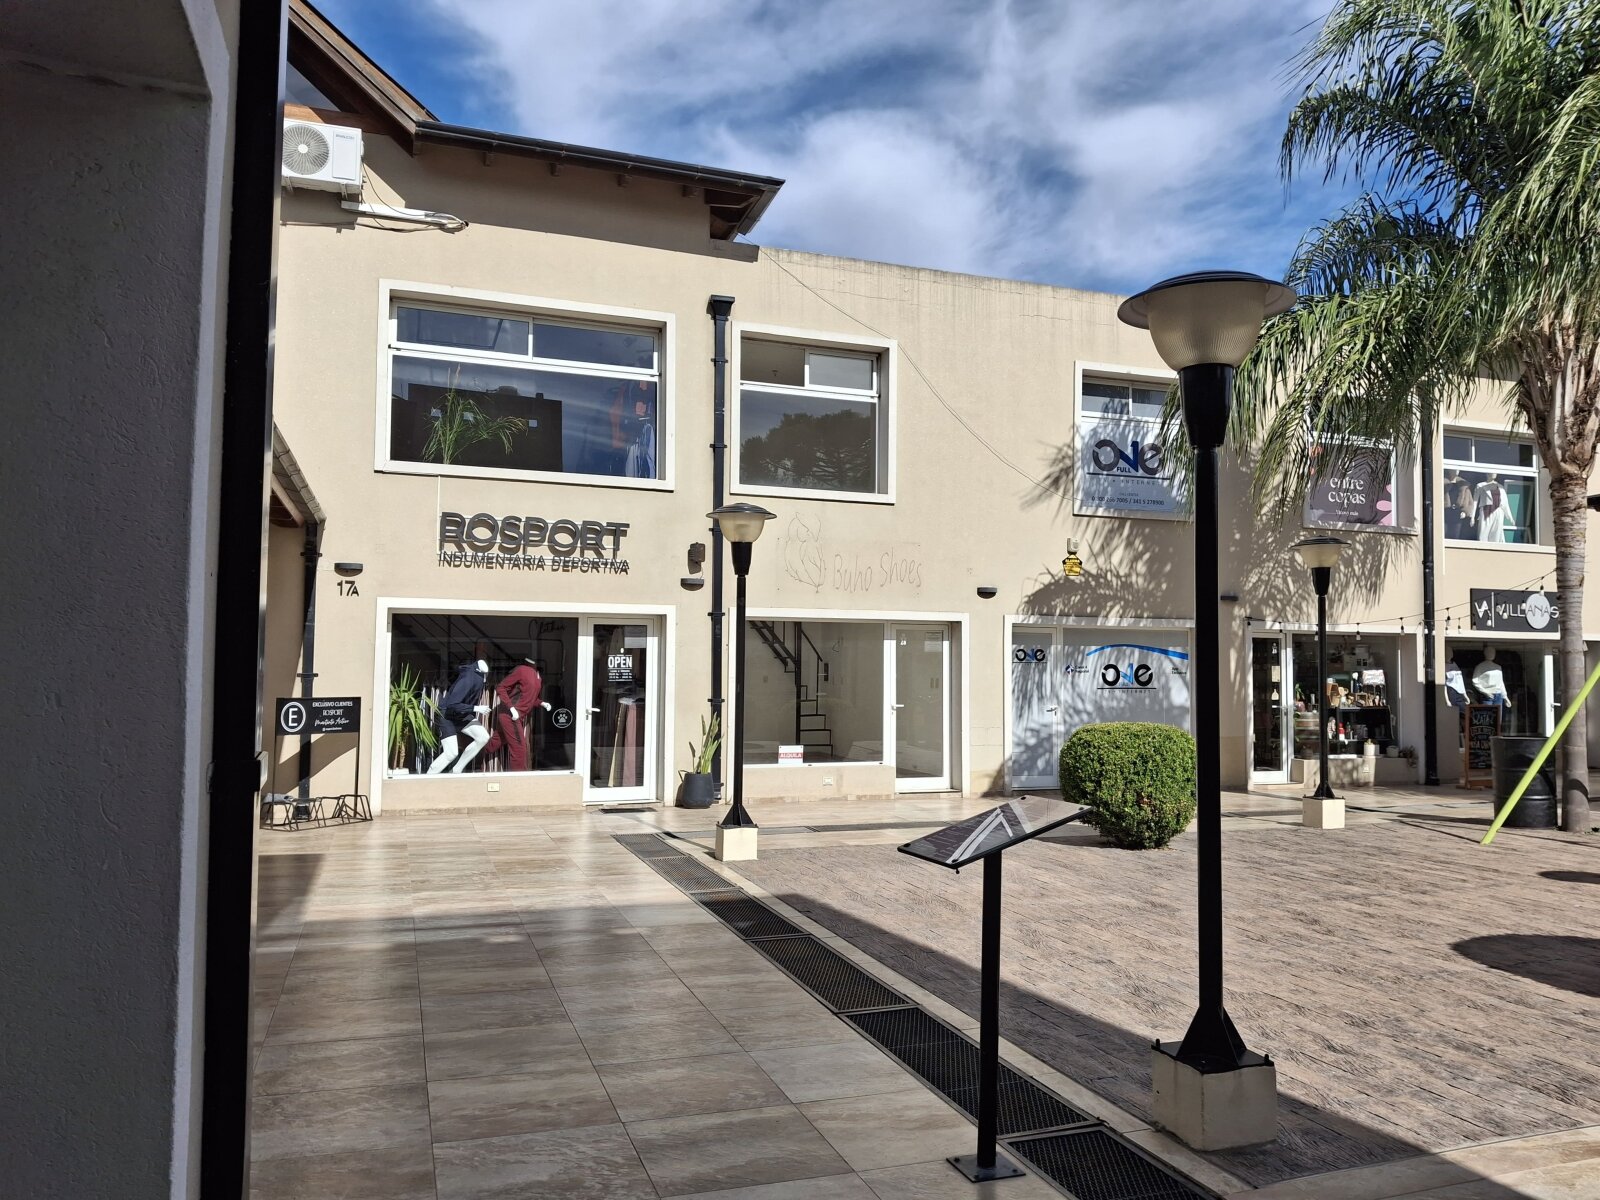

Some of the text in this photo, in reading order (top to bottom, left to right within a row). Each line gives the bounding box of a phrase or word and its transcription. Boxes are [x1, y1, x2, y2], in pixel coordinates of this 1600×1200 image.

[1328, 491, 1366, 508] copas
[440, 511, 630, 553] ROSPORT
[439, 551, 630, 573] INDUMENTARIA DEPORTIVA
[880, 546, 922, 588] Shoes
[337, 579, 360, 597] 17A
[608, 656, 632, 668] OPEN
[288, 707, 298, 727] E
